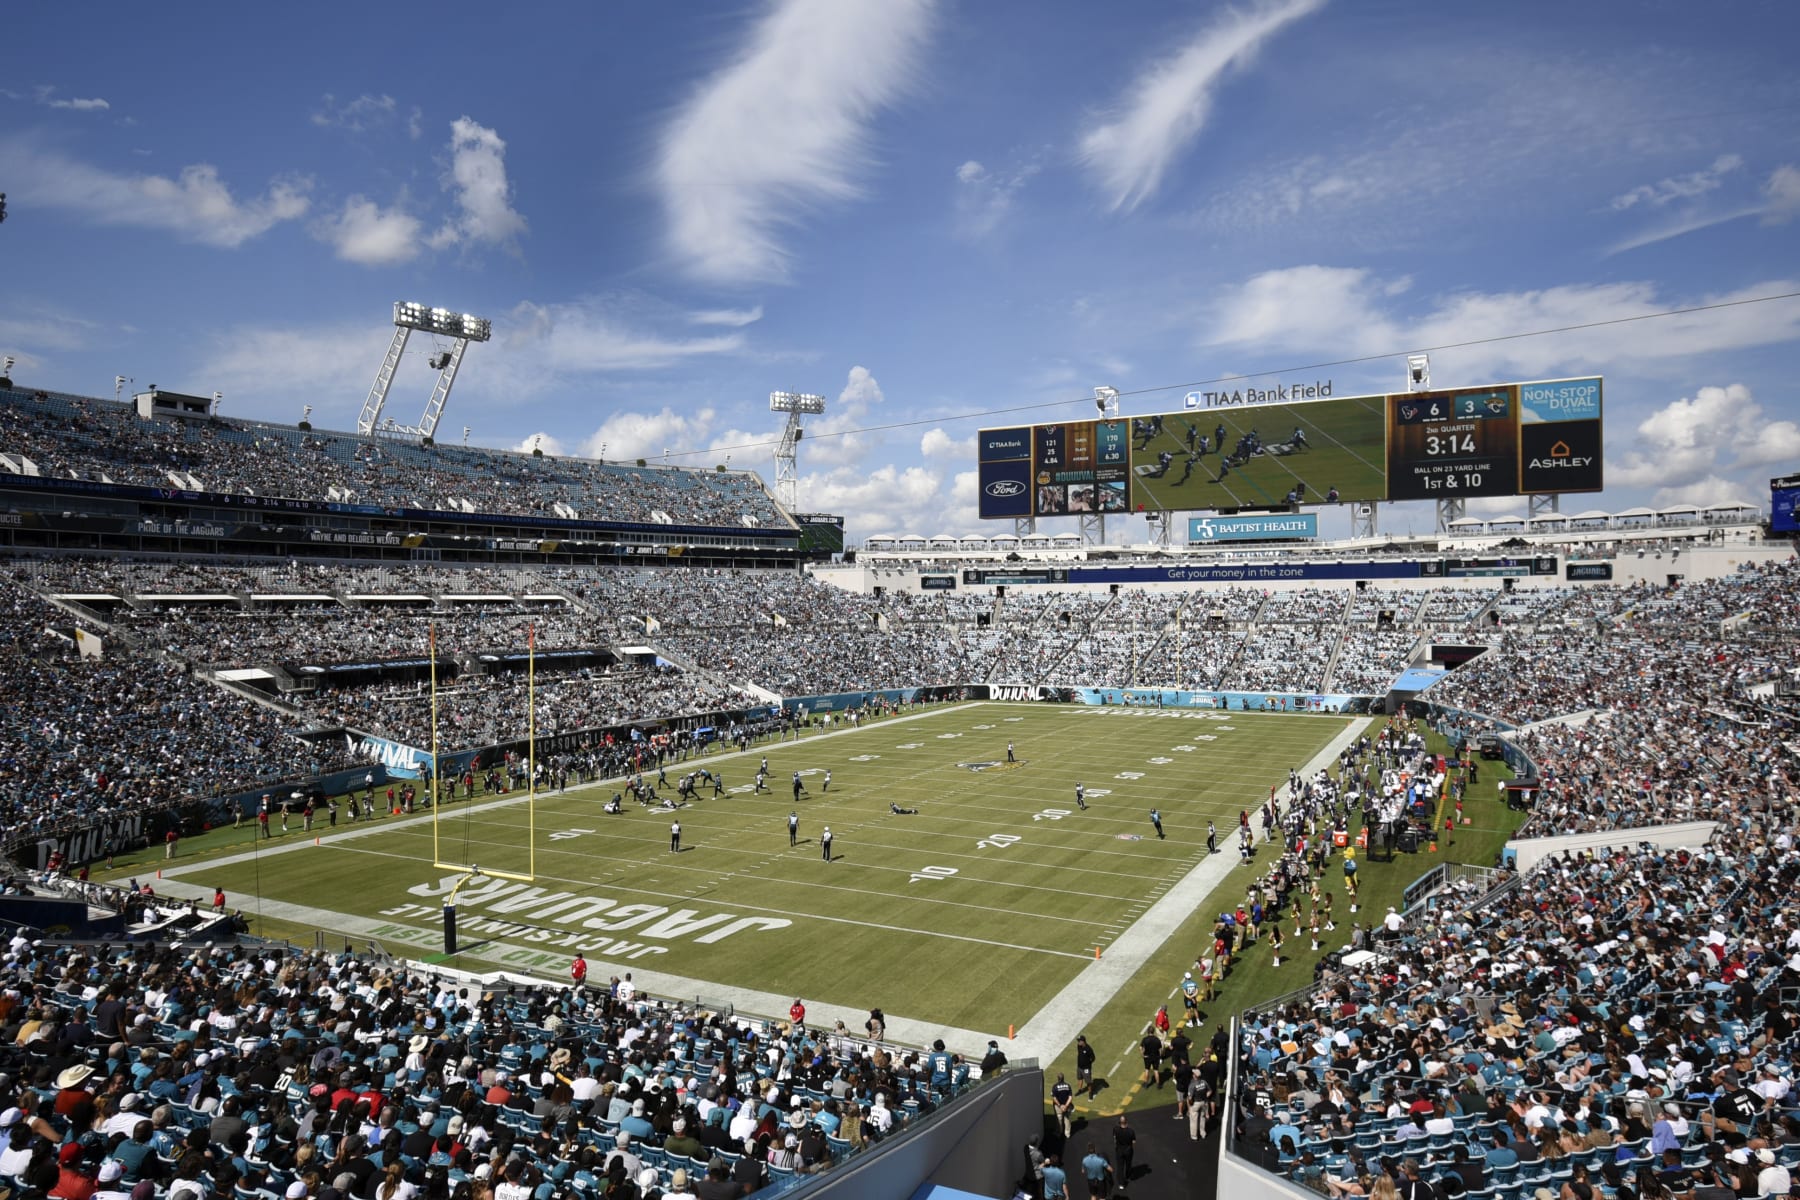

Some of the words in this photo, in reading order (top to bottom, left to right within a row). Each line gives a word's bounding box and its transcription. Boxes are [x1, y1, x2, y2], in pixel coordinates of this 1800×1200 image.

[1203, 390, 1242, 407] TIAA
[1247, 384, 1287, 403] Bank
[1291, 380, 1332, 399] Field
[1524, 386, 1596, 401] NON-STOP
[1430, 403, 1439, 415] 6
[1465, 401, 1474, 413] 3
[1550, 397, 1595, 409] DUVAL
[1441, 424, 1475, 433] QUARTER
[1426, 434, 1475, 455] 3:14
[1454, 464, 1473, 472] YARD
[1529, 457, 1592, 469] ASHLEY
[1424, 476, 1442, 489] 1ST
[1446, 475, 1458, 488] &
[1464, 473, 1481, 487] 10
[993, 483, 1017, 495] Ford
[138, 522, 161, 533] PRIDE
[163, 523, 173, 534] OF
[175, 524, 189, 534] THE
[191, 525, 224, 537] JAGUARS
[1220, 523, 1261, 533] BAPTIST
[1264, 521, 1307, 531] HEALTH
[310, 532, 332, 542] WAYNE
[333, 533, 347, 543] AND
[348, 534, 375, 544] DELORES
[376, 535, 400, 545] WEAVER
[1168, 569, 1185, 578] Get
[1188, 570, 1209, 580] your
[1212, 569, 1245, 580] money
[1248, 568, 1257, 577] in
[1260, 567, 1276, 576] the
[1279, 568, 1303, 576] zone
[1571, 566, 1606, 577] JAGUARS
[990, 684, 1045, 701] DUUUVAL
[1033, 809, 1072, 821] 30
[976, 834, 1022, 849] 20
[909, 866, 958, 883] 10
[407, 872, 793, 944] JAGUARS
[501, 949, 572, 971] END
[620, 988, 627, 998] 5
[936, 1061, 946, 1072] 16
[274, 1073, 293, 1091] 20
[1256, 1097, 1270, 1108] 93
